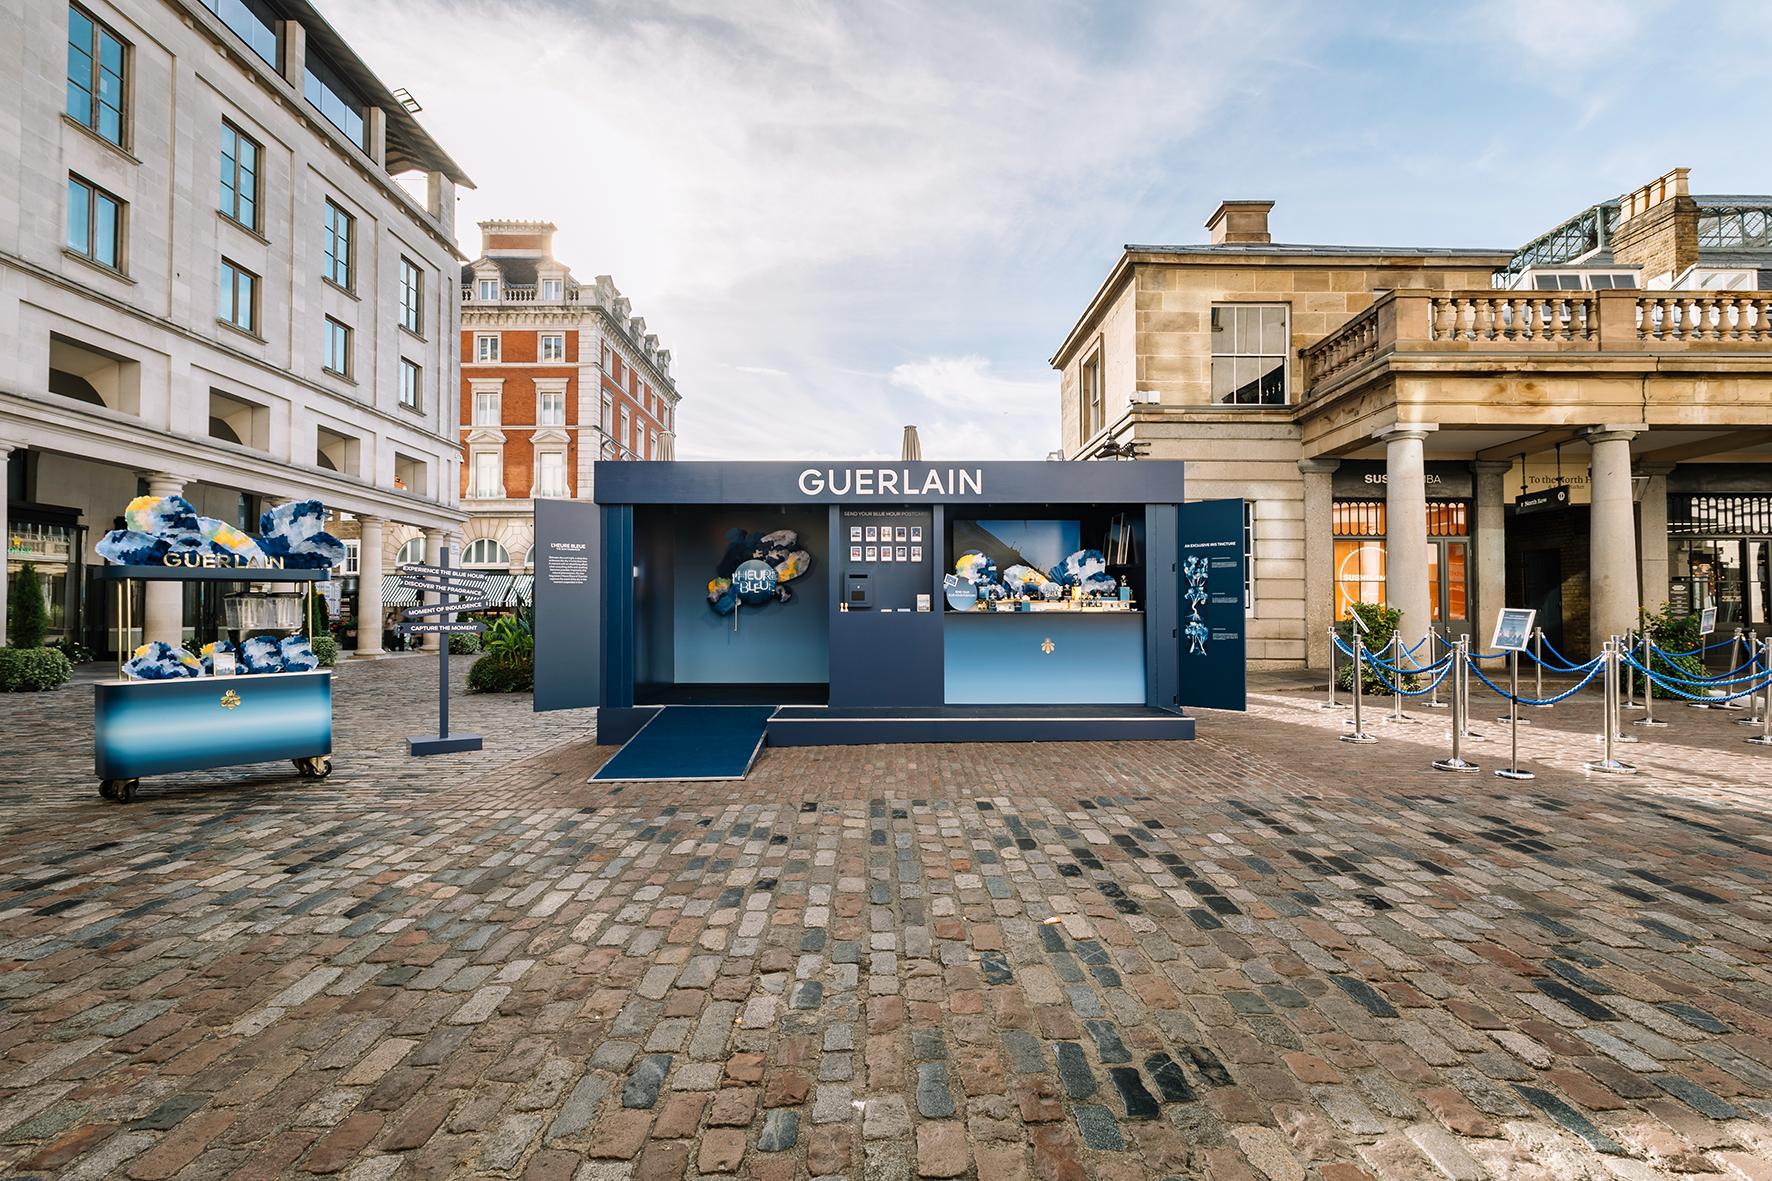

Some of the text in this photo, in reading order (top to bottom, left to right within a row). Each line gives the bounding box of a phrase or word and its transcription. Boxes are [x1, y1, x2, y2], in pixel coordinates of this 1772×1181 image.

[798, 469, 982, 496] GUERLAIN
[1529, 476, 1540, 484] To
[1542, 475, 1556, 484] the
[1524, 498, 1537, 506] North
[7, 546, 32, 556] OLEX
[162, 552, 285, 570] GUERLAIN
[402, 566, 439, 575] EXPERIENCE
[467, 572, 484, 580] HOUR
[404, 580, 435, 589] DISCOVER
[447, 586, 482, 596] FRAGRANCE
[740, 581, 776, 593] BLEUE
[408, 607, 435, 616] MOMENT
[445, 602, 482, 611] INDULGENCE
